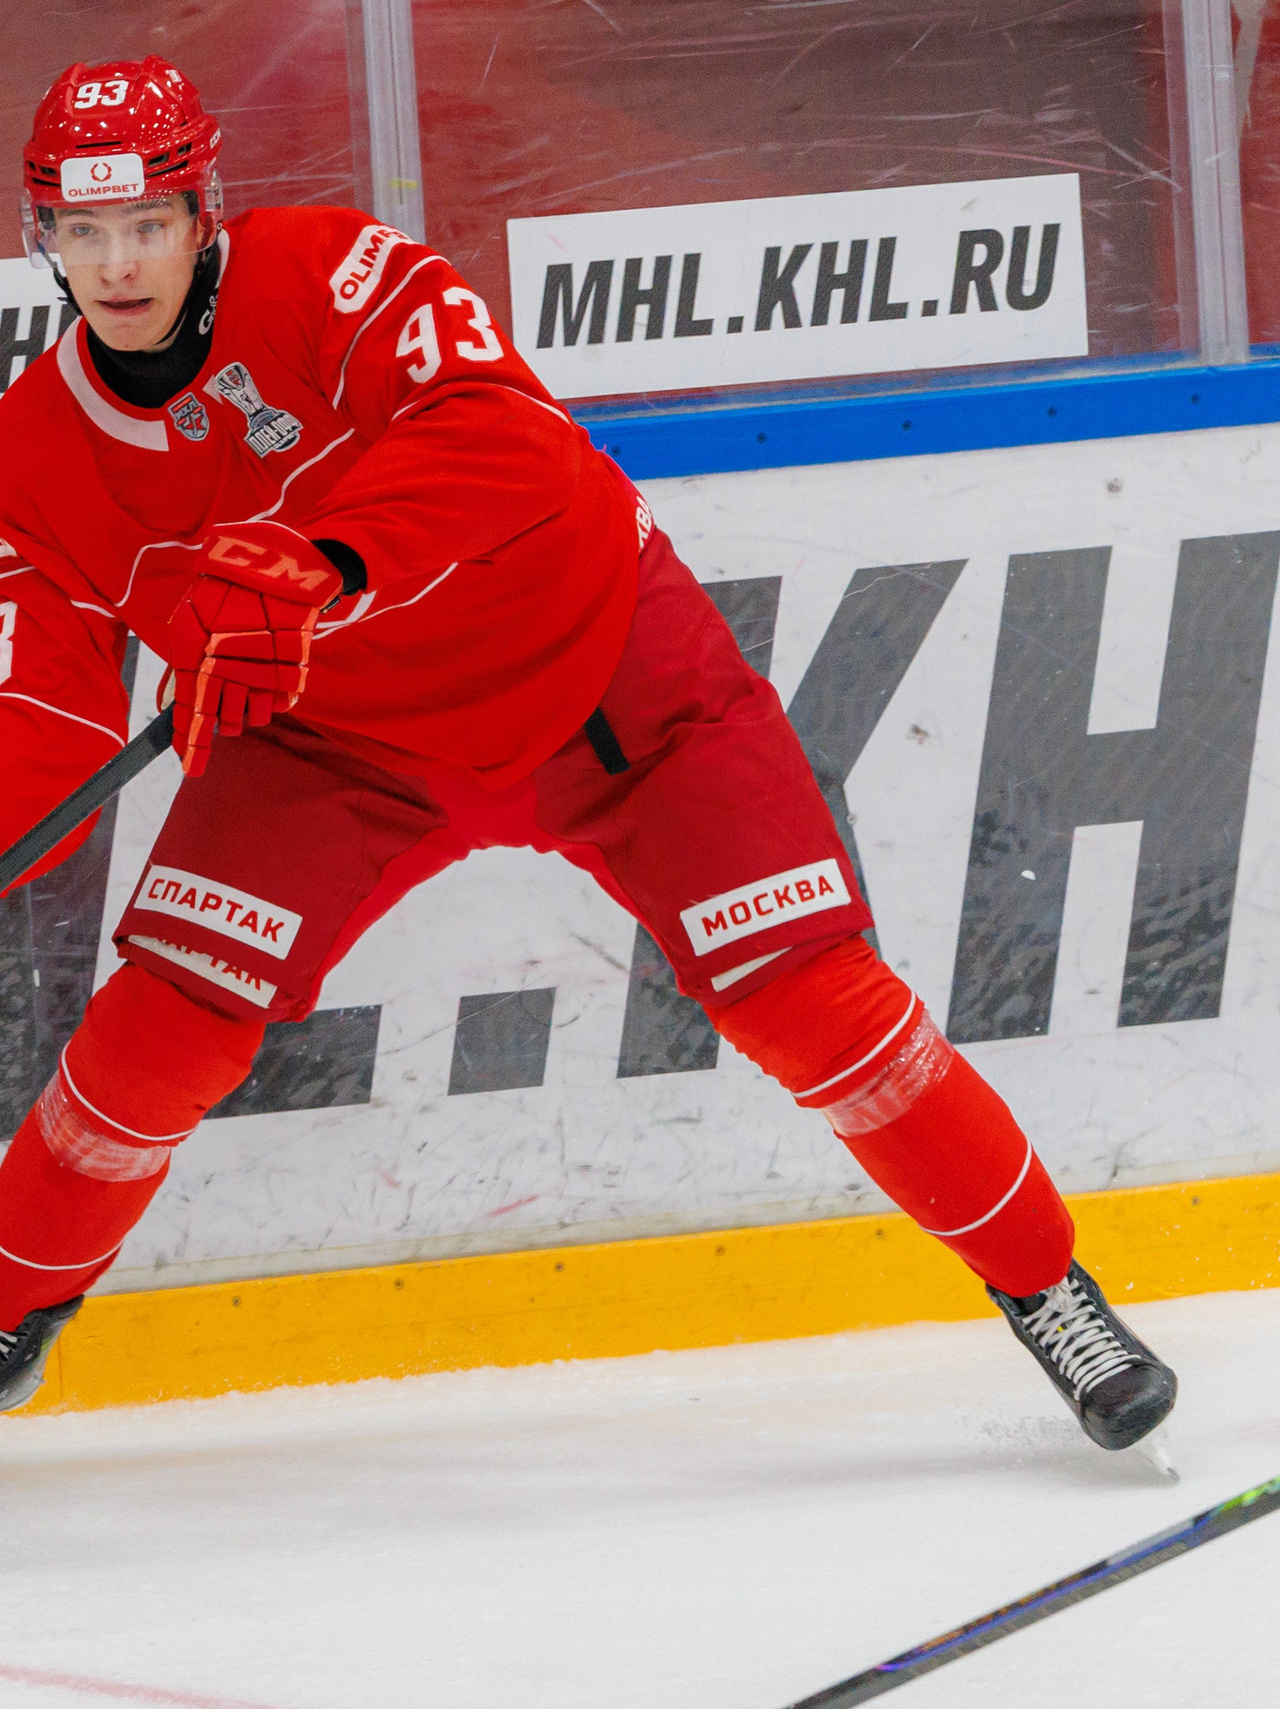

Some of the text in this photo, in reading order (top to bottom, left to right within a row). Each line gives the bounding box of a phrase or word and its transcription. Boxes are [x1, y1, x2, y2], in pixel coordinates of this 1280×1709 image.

[74, 79, 129, 110] 93
[68, 183, 140, 198] OLIMPBET
[339, 228, 410, 301] OLIMP
[535, 222, 1062, 349] MHL.KHL.RU
[395, 286, 504, 384] 93
[147, 877, 285, 944] СПАРТАК
[700, 874, 835, 938] МОСКВА
